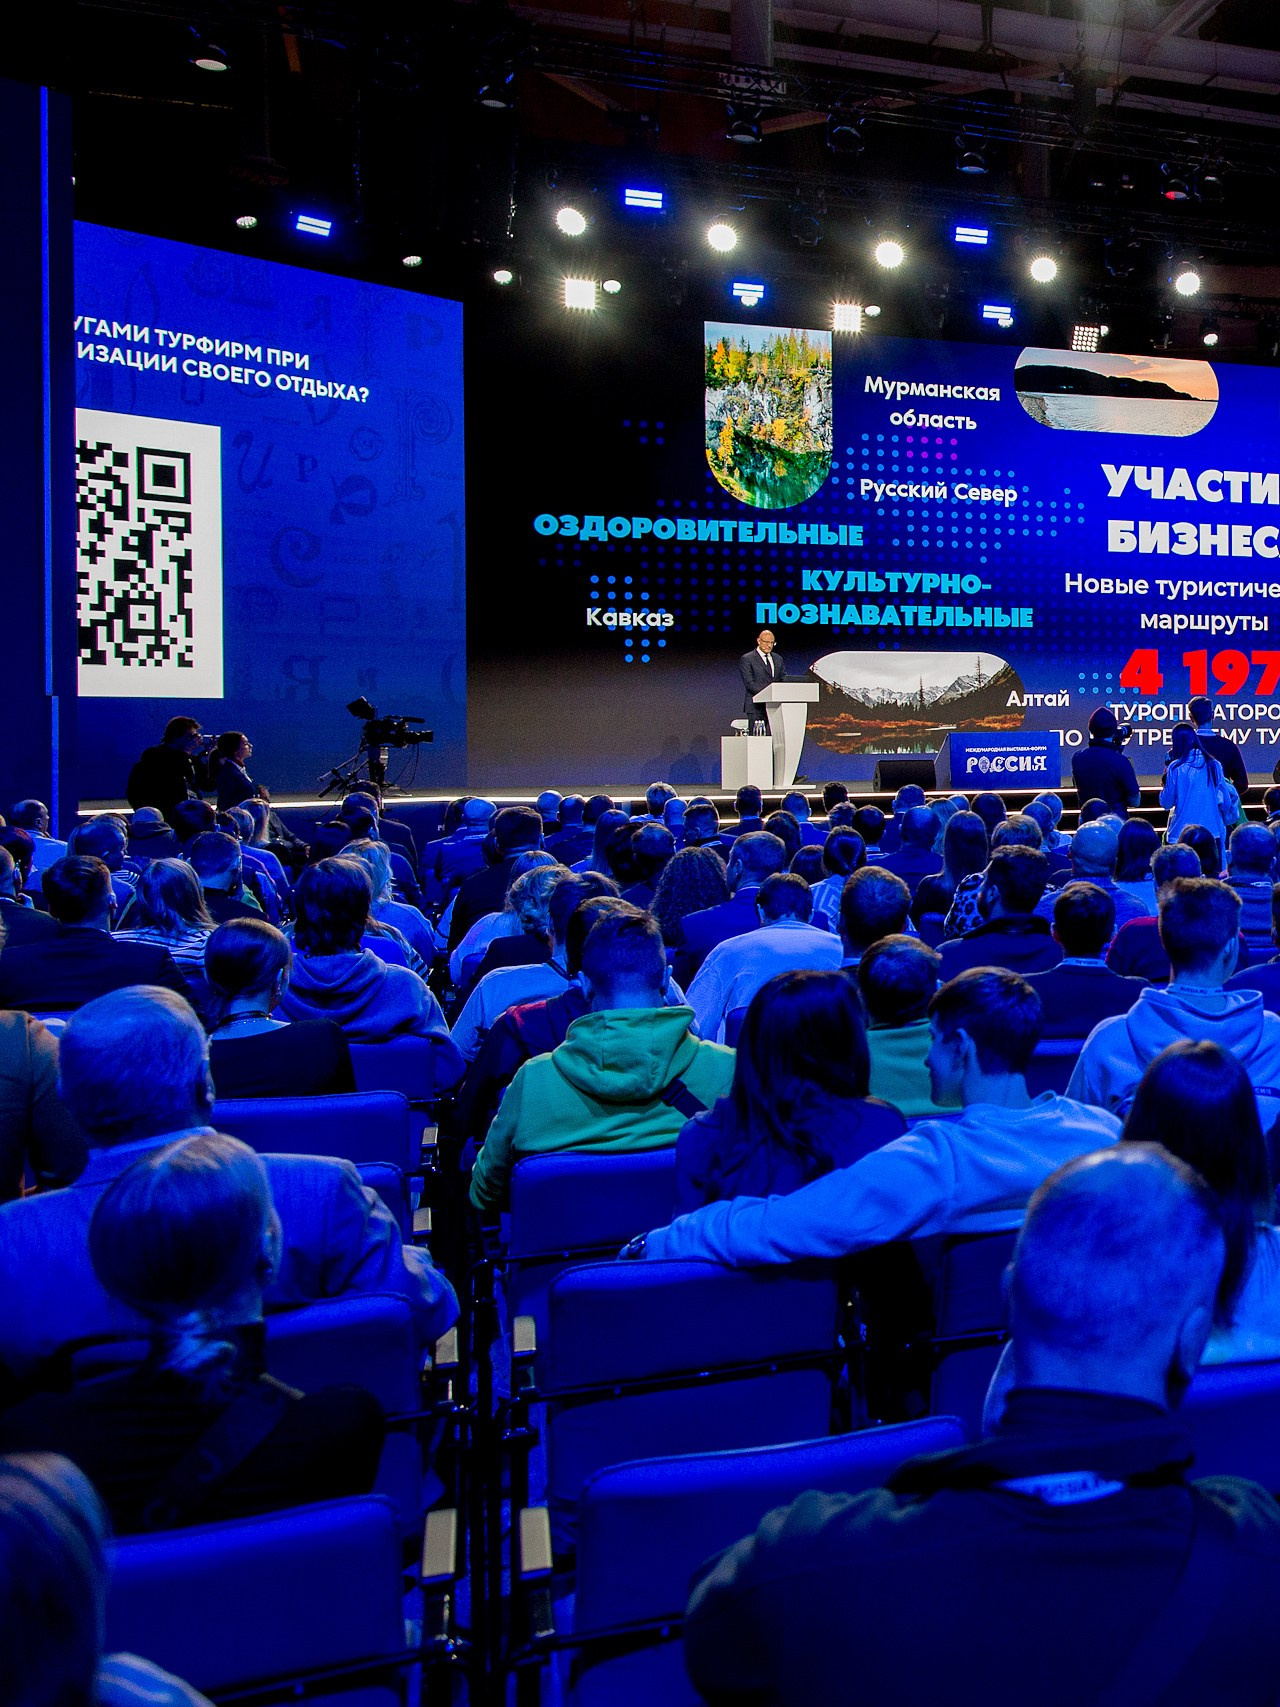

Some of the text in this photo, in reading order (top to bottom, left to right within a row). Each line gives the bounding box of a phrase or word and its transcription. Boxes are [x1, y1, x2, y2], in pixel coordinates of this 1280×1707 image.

[152, 328, 262, 364] ТУРФИРМ
[266, 347, 309, 371] ПРИ
[77, 339, 369, 403] ИЗАЦИИ СВОЕГО ОТДЫХА?
[864, 375, 1001, 402] Мурманская
[889, 408, 977, 430] область
[860, 478, 1018, 508] Русский Север
[534, 513, 864, 547] ОЗДОРОВИТЕЛЬНЫЕ
[802, 569, 992, 595] КУЛЬТУРНО-
[1065, 572, 1150, 595] Новые
[586, 607, 675, 627] Кавказ
[756, 602, 1034, 628] ПОЗНАВАТЕЛЬНЫЕ
[1140, 613, 1269, 636] маршруты
[1120, 649, 1163, 695] 4
[1005, 689, 1070, 707] Алтай
[965, 755, 1048, 774] РОССИЯ
